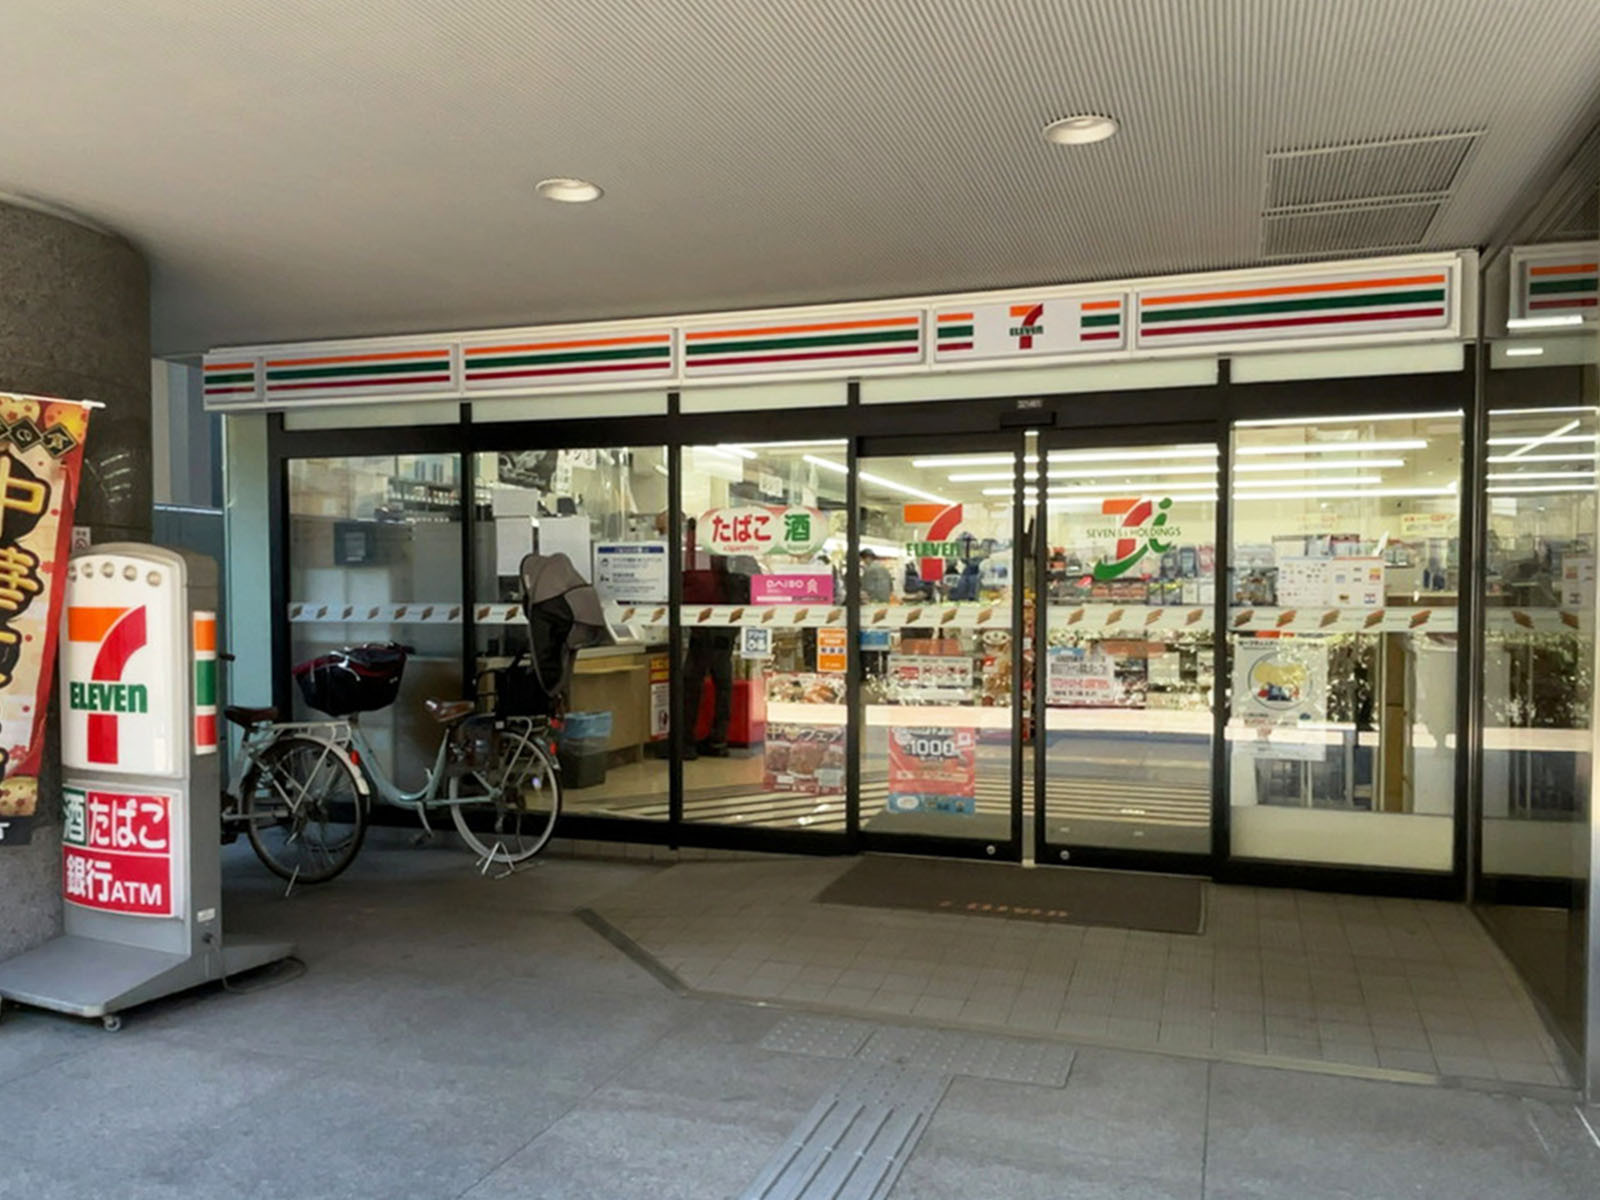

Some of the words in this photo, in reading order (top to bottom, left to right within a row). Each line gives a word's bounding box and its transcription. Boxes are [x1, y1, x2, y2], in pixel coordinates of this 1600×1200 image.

[712, 513, 772, 542] たばこ
[784, 513, 810, 541] 酒
[1086, 528, 1116, 538] SEVEN
[1130, 526, 1182, 537] HOLDINGS
[67, 605, 147, 764] 7
[63, 793, 85, 843] 酒
[90, 798, 167, 850] たばこ
[66, 854, 162, 905] 銀行ATM
